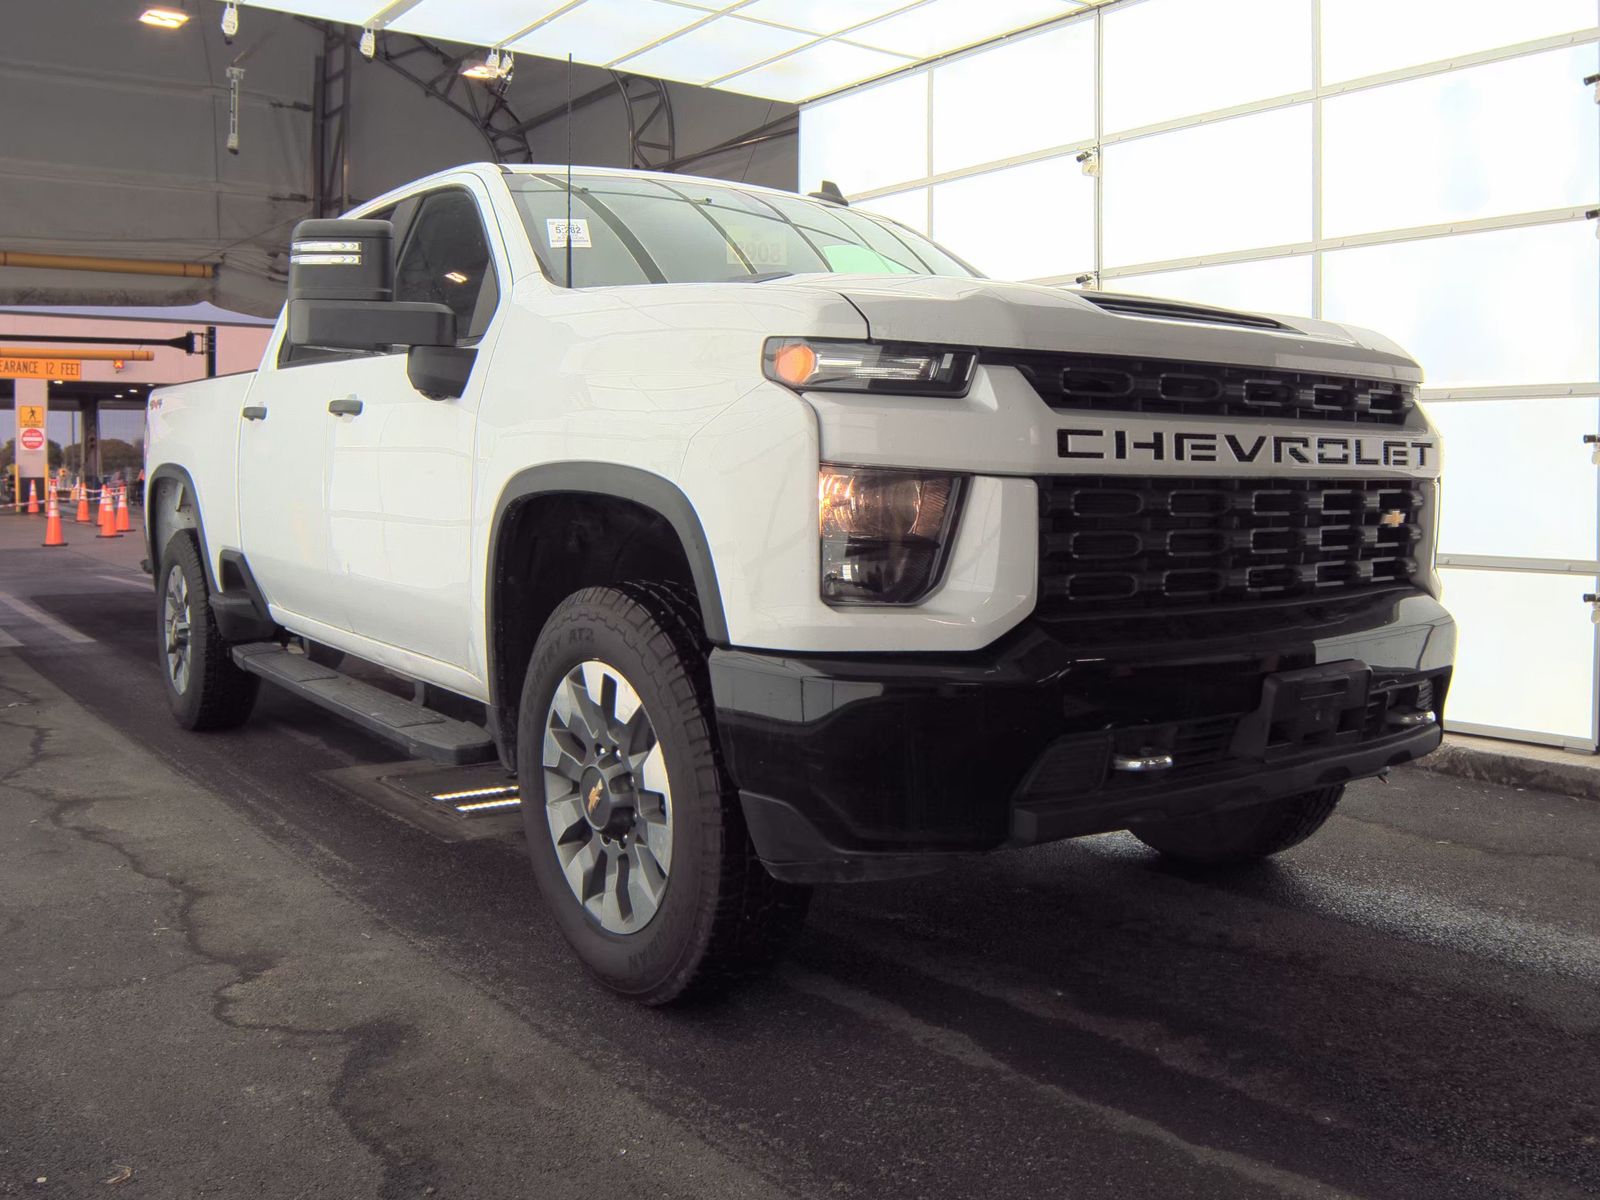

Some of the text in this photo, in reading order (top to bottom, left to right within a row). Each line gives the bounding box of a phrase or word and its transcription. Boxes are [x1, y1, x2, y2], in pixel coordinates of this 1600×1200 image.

[46, 362, 55, 375] 12
[61, 363, 80, 376] FEET
[1057, 428, 1433, 468] CHEVROLET
